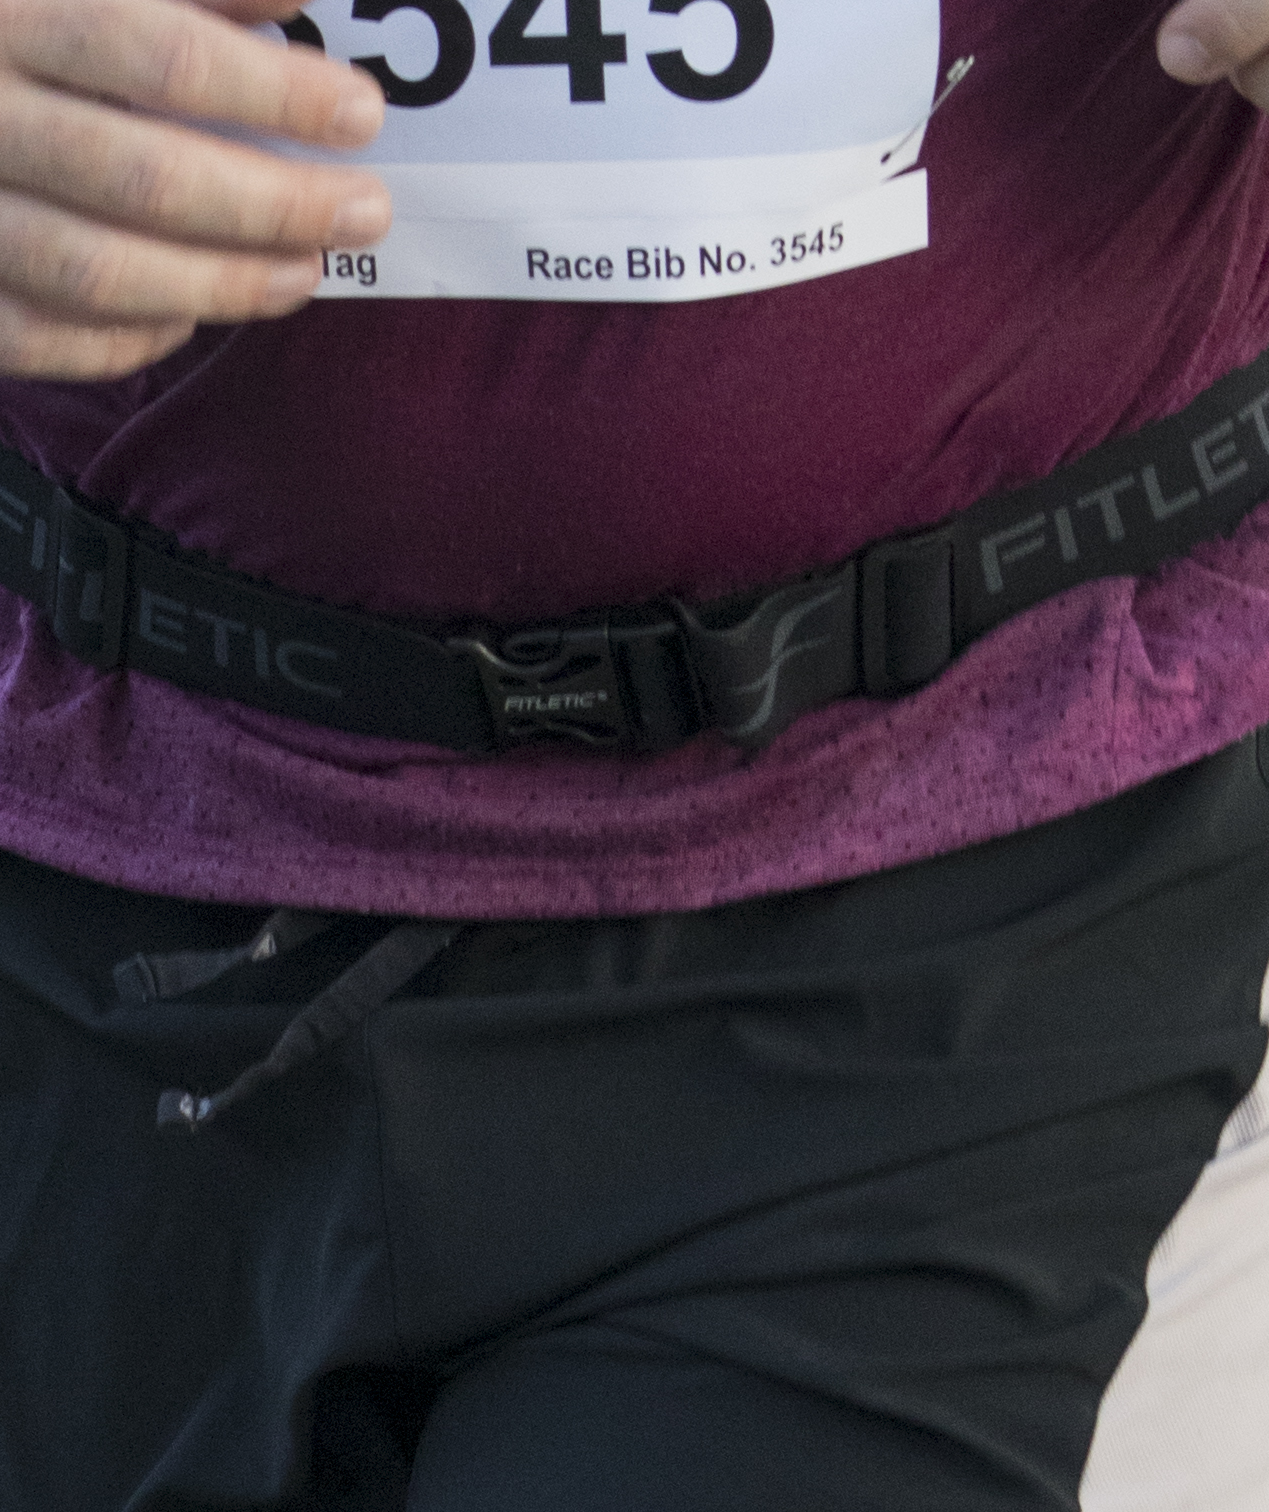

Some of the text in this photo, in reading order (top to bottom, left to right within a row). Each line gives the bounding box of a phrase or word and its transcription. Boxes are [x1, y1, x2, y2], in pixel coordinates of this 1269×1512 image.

[526, 221, 845, 280] Race Bib No. 3545
